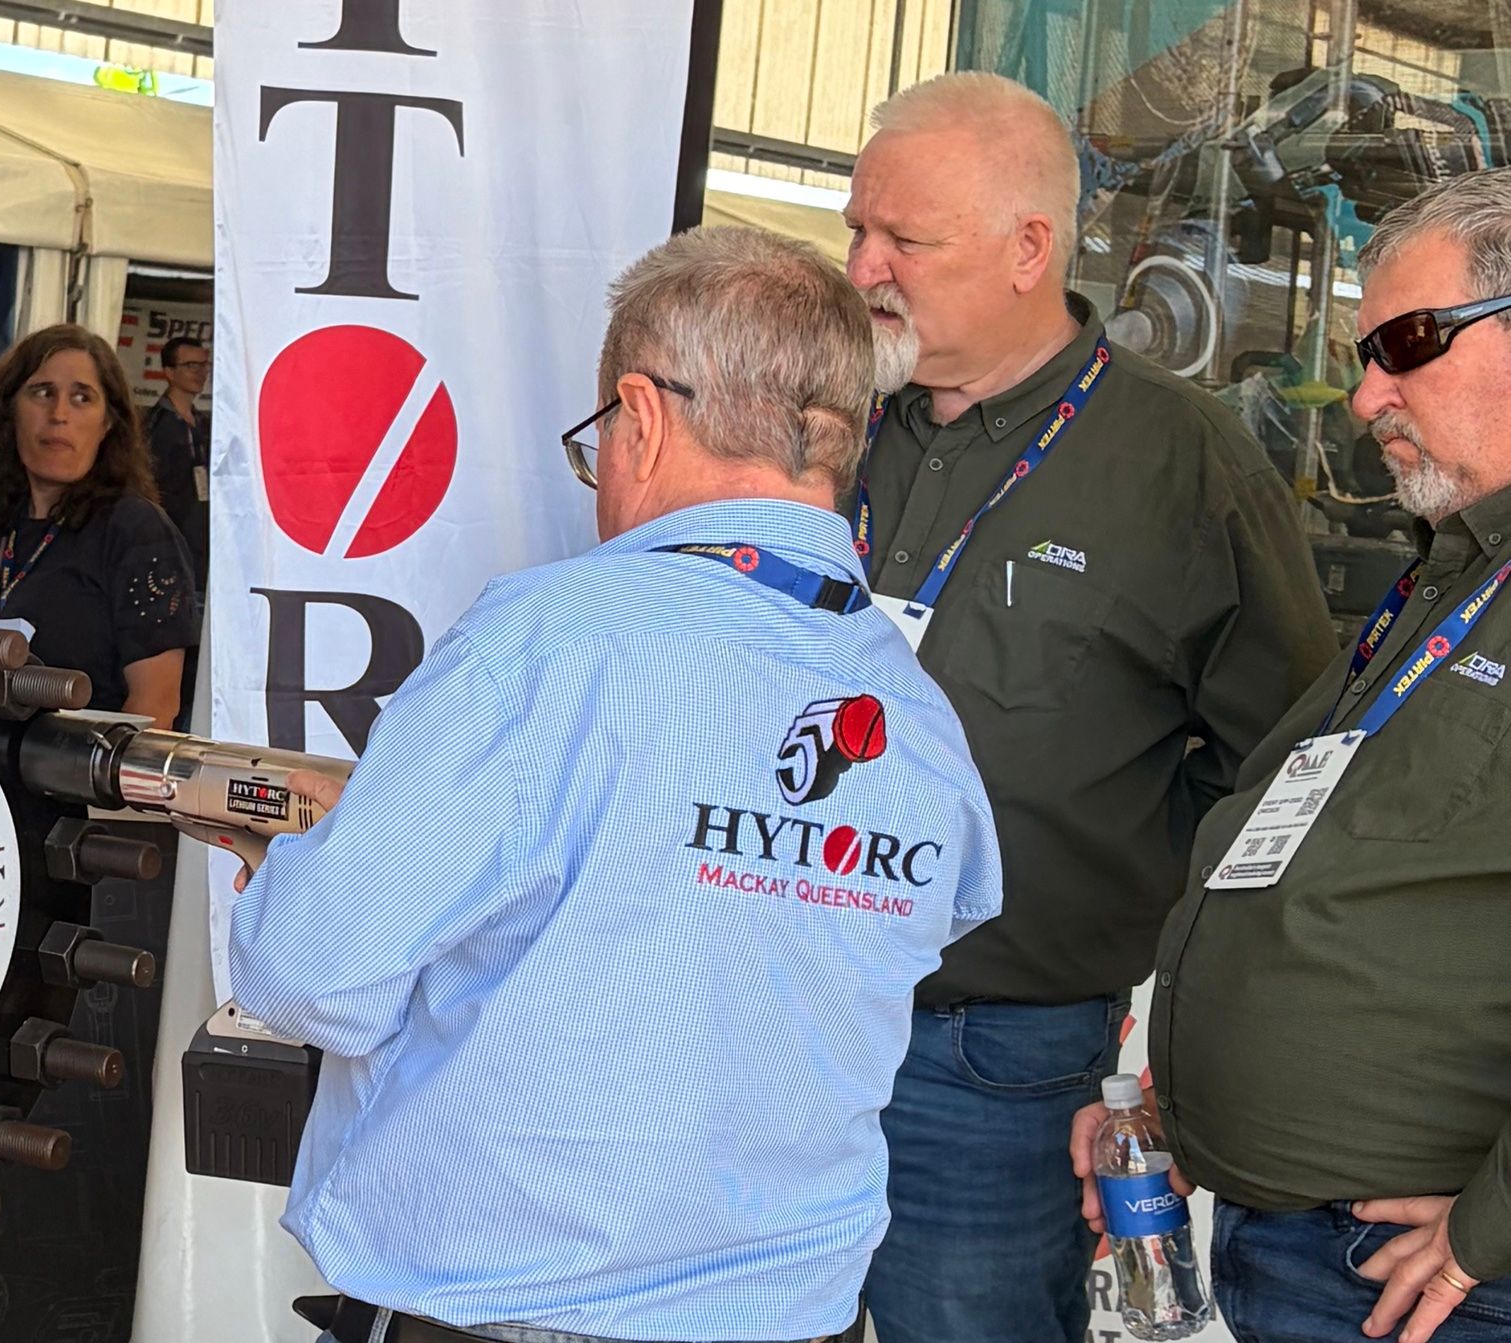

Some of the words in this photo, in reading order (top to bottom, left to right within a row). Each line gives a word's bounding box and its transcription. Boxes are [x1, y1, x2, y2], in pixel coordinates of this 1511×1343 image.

[1077, 358, 1104, 393] PIRTEK
[1037, 415, 1065, 451] PIRTEK
[1459, 579, 1499, 624] PIRTEK
[1366, 608, 1394, 649] PIRTEK
[1392, 650, 1435, 697] PIRTEK
[232, 782, 287, 802] HYTORC
[684, 801, 944, 888] HYTORC
[696, 862, 790, 898] MACKAY
[795, 878, 915, 917] QUEENSLAND
[1124, 1191, 1185, 1214] VERD
